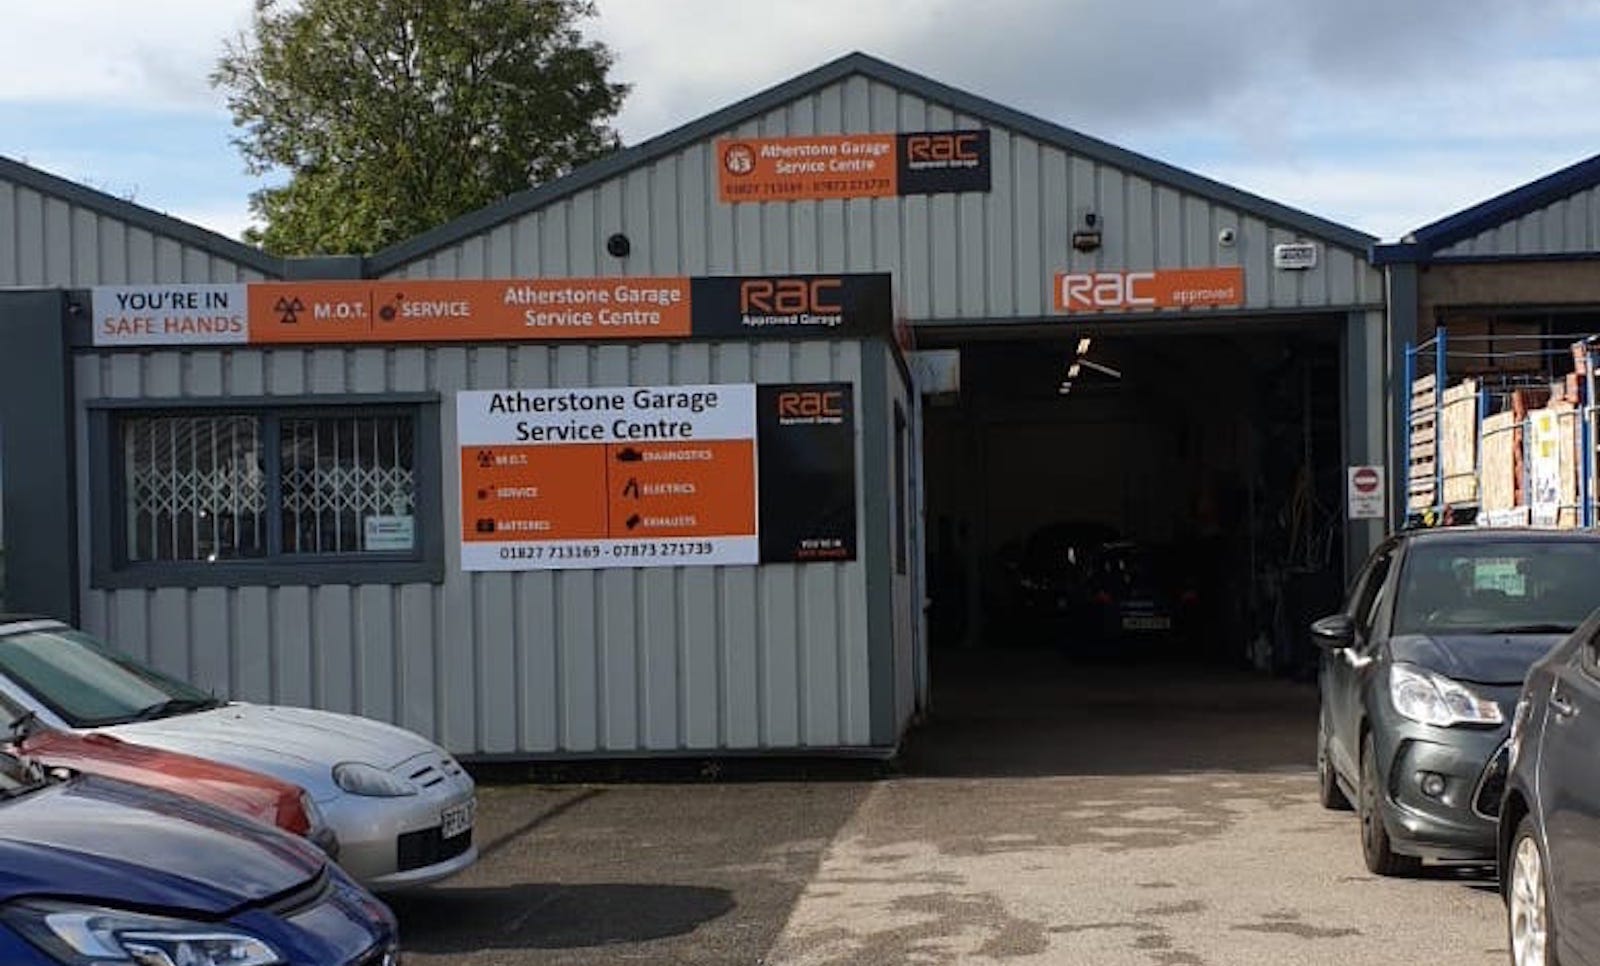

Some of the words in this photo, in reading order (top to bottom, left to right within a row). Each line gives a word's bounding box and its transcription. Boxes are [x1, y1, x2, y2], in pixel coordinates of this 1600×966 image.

[761, 143, 837, 159] Atherstone
[841, 140, 890, 156] Garage
[776, 159, 825, 175] Service
[829, 158, 875, 173] Centre
[116, 291, 198, 310] YOU'RE
[206, 291, 228, 309] IN
[504, 286, 608, 305] Atherstone
[614, 285, 681, 304] Garage
[1172, 286, 1235, 304] approved
[314, 303, 367, 321] M.O.T.
[402, 301, 470, 318] SERVICE
[525, 308, 593, 327] Service
[598, 308, 660, 326] Centre
[104, 315, 155, 334] SAFE
[164, 313, 243, 333] HANDS
[742, 314, 798, 326] Approved
[489, 391, 625, 413] Atherstone
[633, 390, 718, 411] Garage
[516, 420, 604, 441] Service
[612, 419, 693, 439] Centre
[500, 546, 543, 559] 01827
[549, 545, 600, 559] 713169
